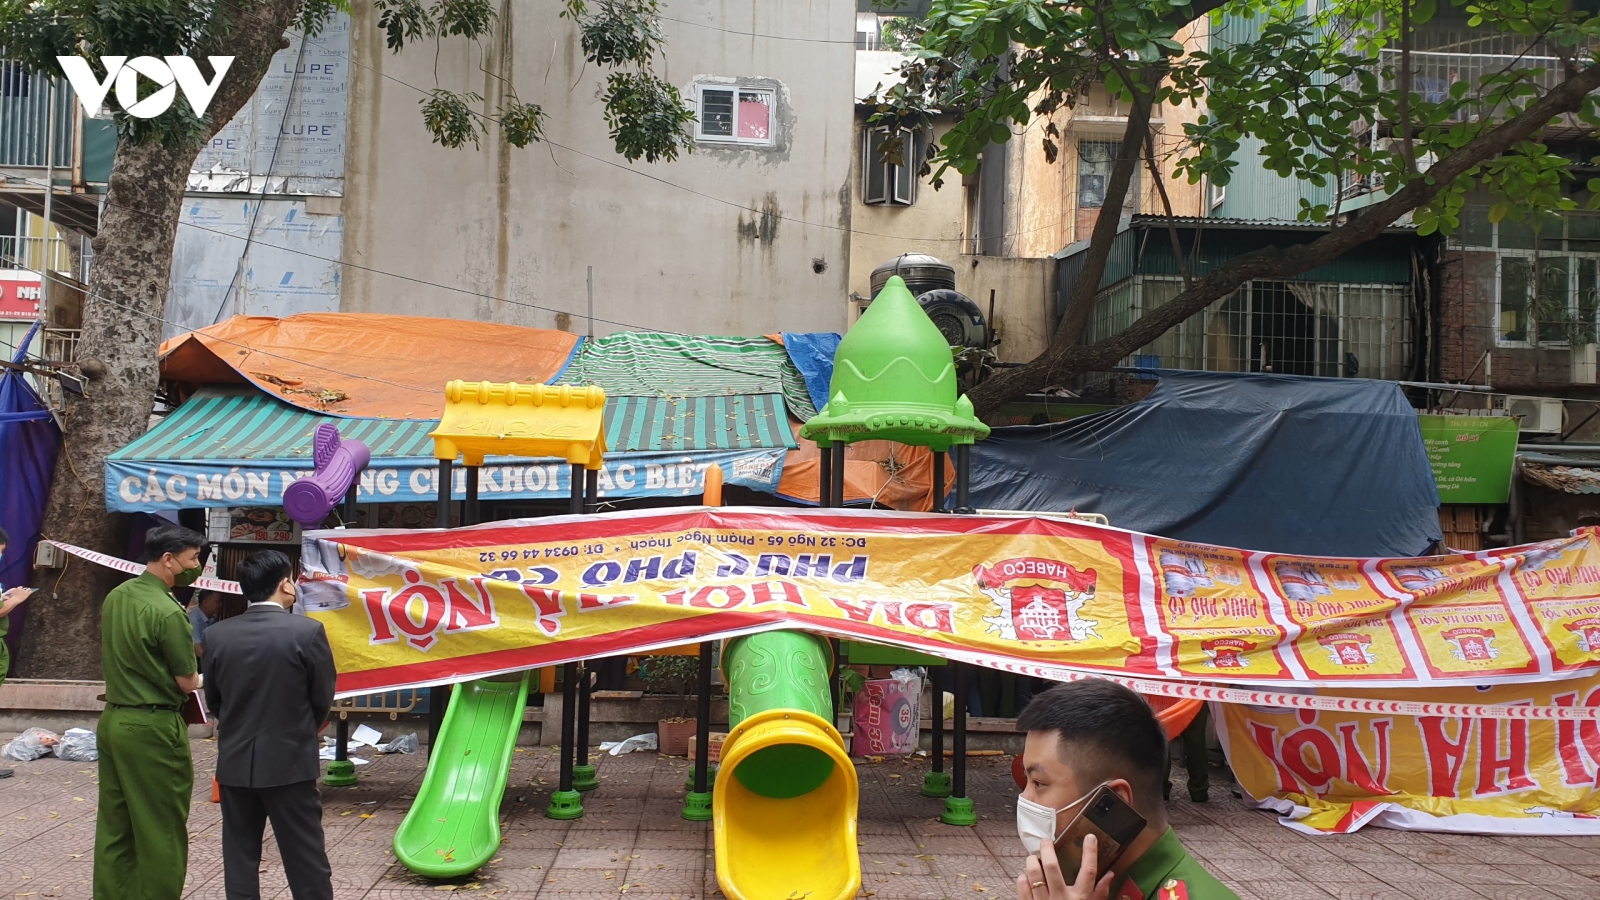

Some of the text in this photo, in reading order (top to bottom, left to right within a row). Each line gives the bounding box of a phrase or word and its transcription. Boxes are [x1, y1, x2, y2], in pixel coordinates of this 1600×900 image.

[119, 468, 187, 502] CÁC
[196, 467, 271, 500] MÓN
[280, 469, 400, 497] NNG
[274, 532, 290, 541] 290
[717, 533, 755, 546] Phạm
[767, 535, 783, 547] 65
[788, 535, 816, 547] Ngõ
[820, 536, 837, 547] 32
[842, 537, 867, 548] ĐC:
[501, 551, 519, 560] 66
[523, 548, 540, 559] 44
[545, 546, 579, 557] 0934
[583, 545, 604, 554] ĐT:
[480, 552, 496, 563] 32
[1003, 561, 1068, 578] HABECO
[362, 569, 496, 650] NỘI
[1167, 596, 1258, 625] PHÚC PHỐ CỔ
[1418, 614, 1506, 627] BIA HƠI HÀ NỘI
[865, 683, 886, 726] Kem
[901, 709, 909, 723] 35
